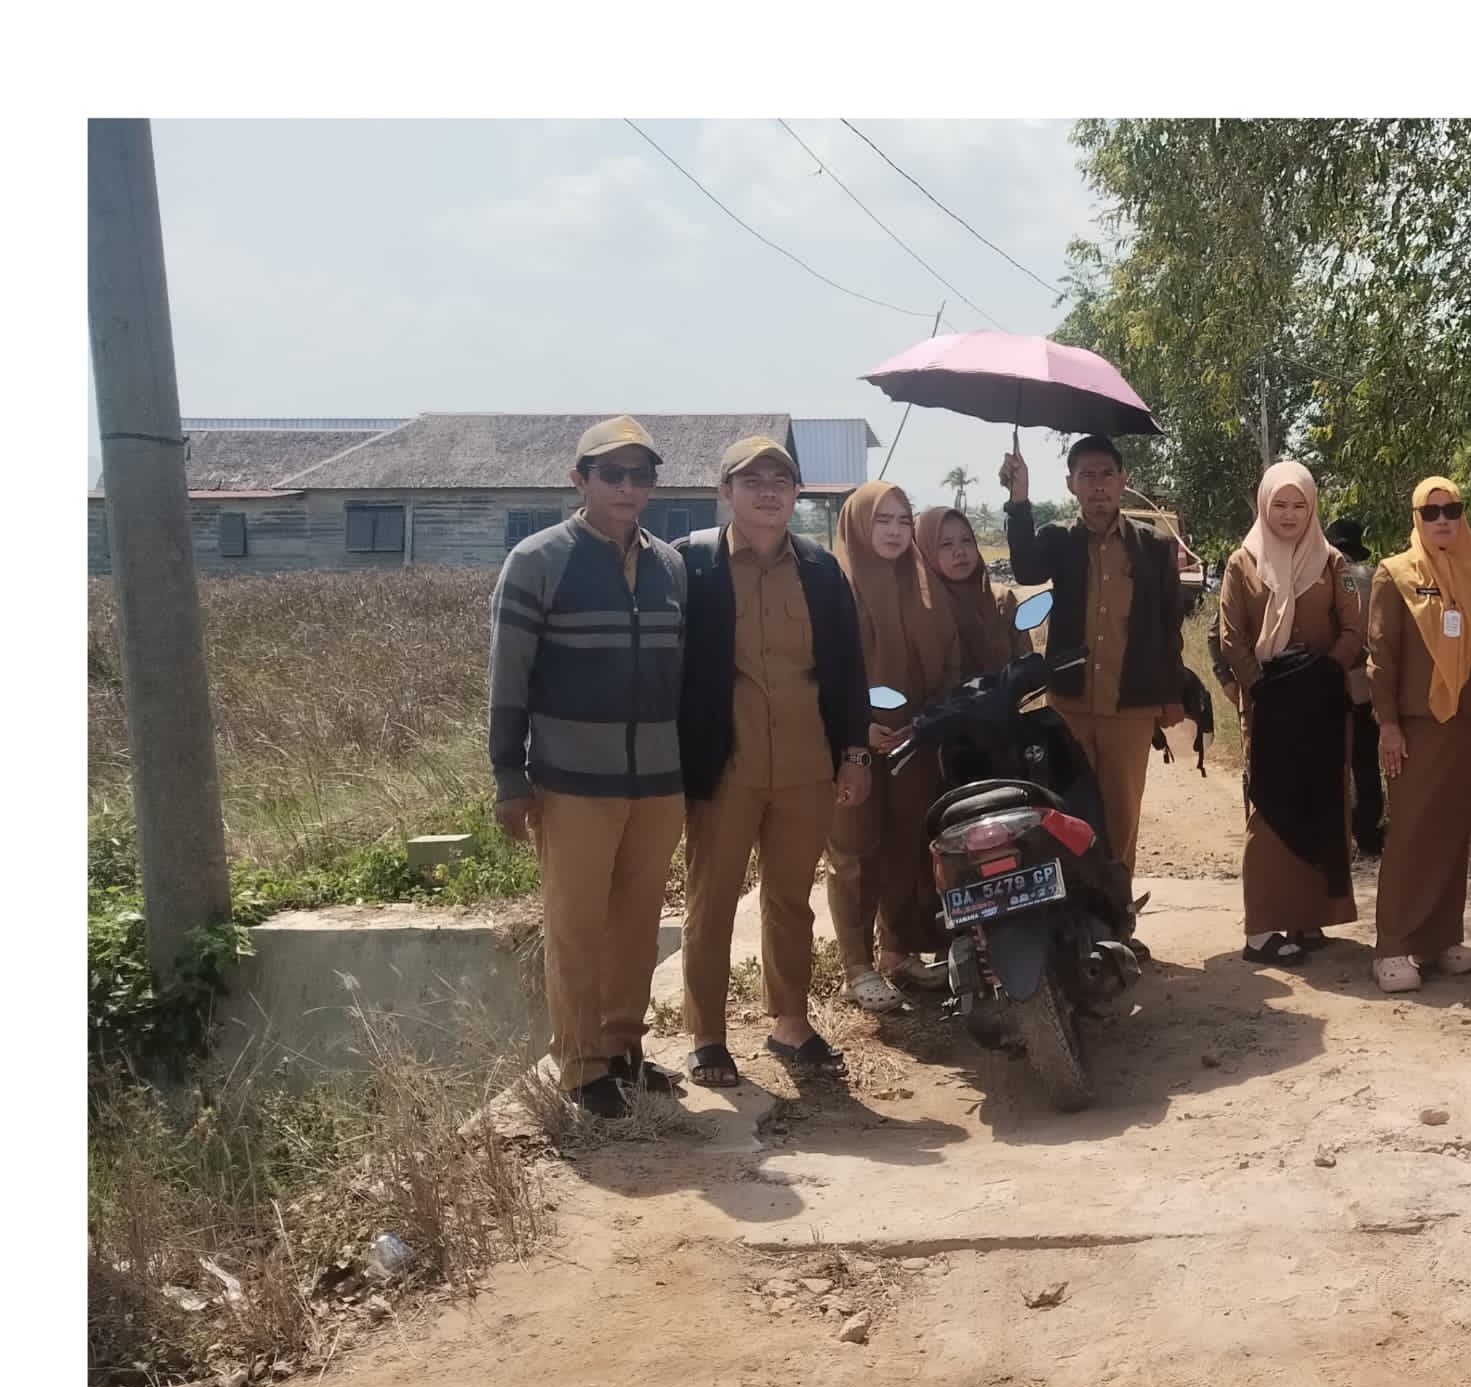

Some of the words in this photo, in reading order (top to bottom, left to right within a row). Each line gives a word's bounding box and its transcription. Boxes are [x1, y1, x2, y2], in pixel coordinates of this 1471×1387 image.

[951, 890, 974, 907] DA
[983, 876, 1025, 898] 5479
[1032, 867, 1054, 884] GP
